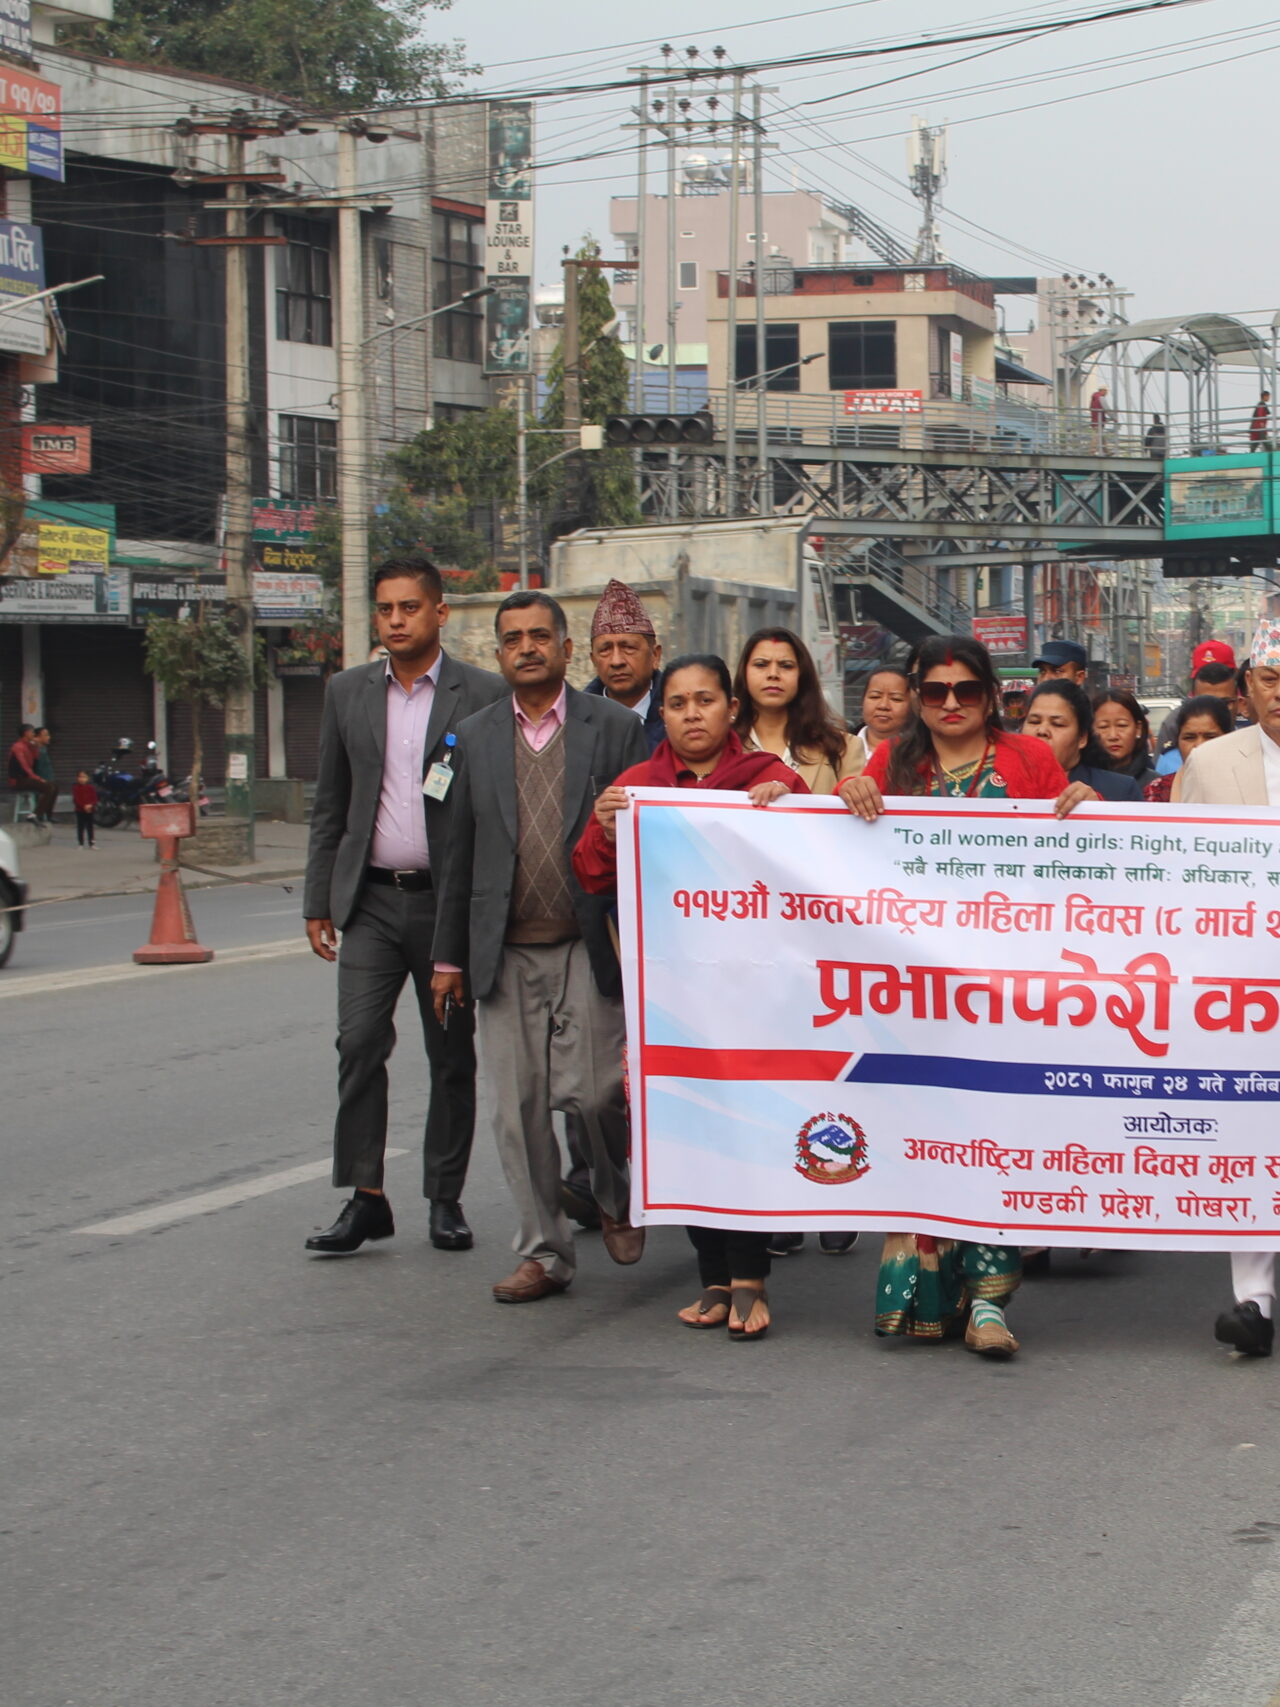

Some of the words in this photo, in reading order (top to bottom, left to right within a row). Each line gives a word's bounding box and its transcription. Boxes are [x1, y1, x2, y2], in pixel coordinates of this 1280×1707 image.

[495, 223, 522, 235] STAR
[487, 236, 530, 248] LOUNGE
[503, 249, 512, 260] &
[497, 261, 519, 273] BAR
[848, 398, 920, 412] JAPAN
[39, 439, 75, 451] IME
[930, 829, 952, 846] all
[958, 833, 1028, 848] women
[1034, 832, 1069, 849] and
[1075, 832, 1124, 854] girls:
[1131, 835, 1188, 855] Right,
[1193, 837, 1273, 858] Equality
[936, 857, 987, 879] महिला
[994, 862, 1026, 879] तथा
[1033, 859, 1117, 881] बालिकाको
[956, 890, 1055, 933] महिला
[1065, 893, 1145, 936] दिवस
[1155, 906, 1182, 936] (८
[1195, 900, 1257, 937] मार्च
[1044, 1071, 1093, 1090] २०८१
[1103, 1073, 1155, 1095] फागुन
[1162, 1075, 1188, 1094] २४
[1198, 1073, 1226, 1093] गते
[1043, 1143, 1125, 1175] महिला
[1134, 1146, 1200, 1177] दिवस
[1208, 1154, 1256, 1184] मूल
[1001, 1185, 1088, 1215] गण्डकी
